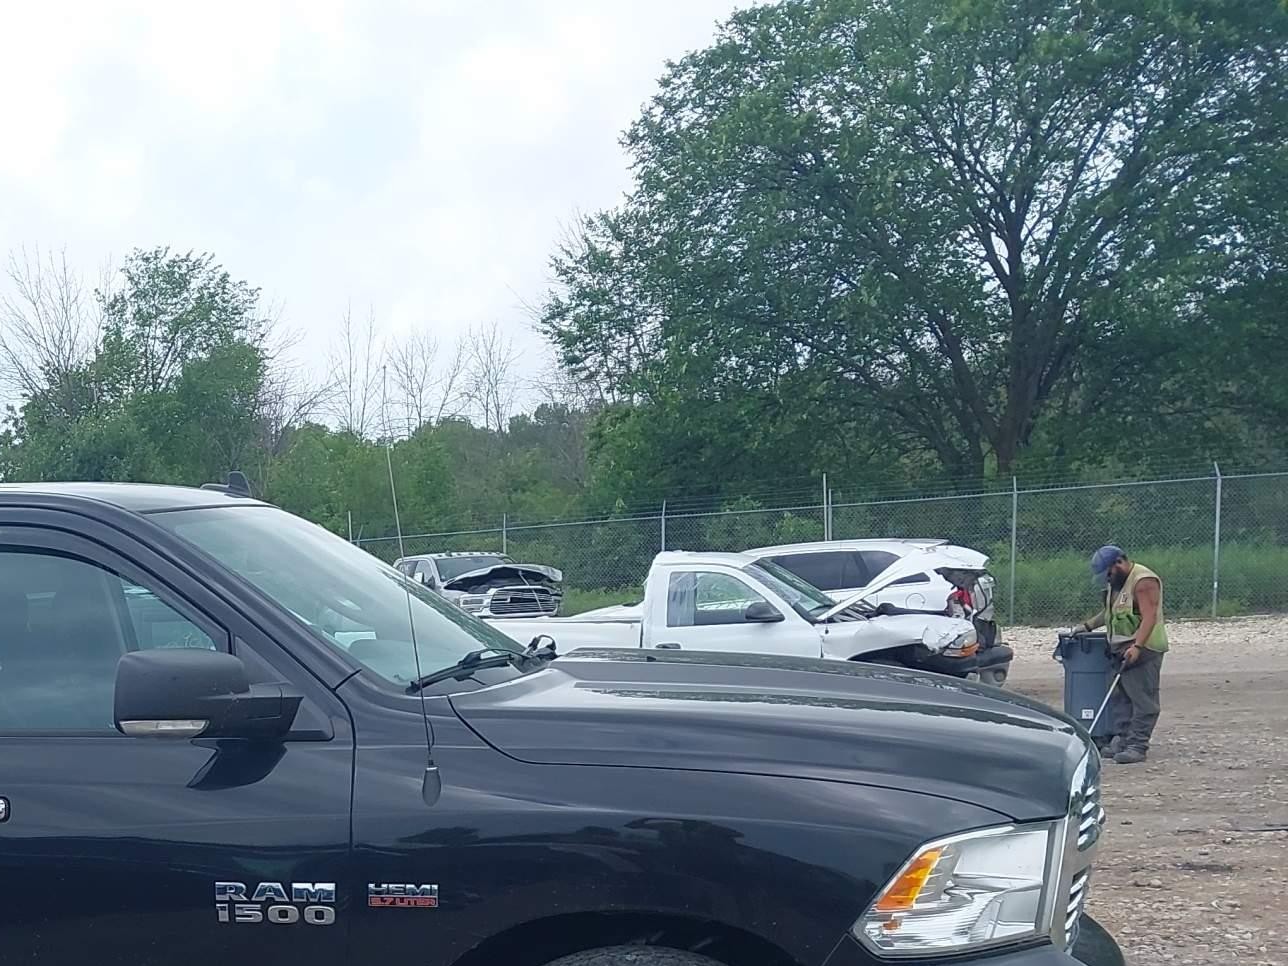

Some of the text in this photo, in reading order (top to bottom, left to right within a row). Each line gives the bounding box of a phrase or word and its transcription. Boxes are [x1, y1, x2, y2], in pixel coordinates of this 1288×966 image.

[215, 881, 336, 902] RAM
[367, 883, 439, 896] HEMI
[215, 903, 336, 925] 1500
